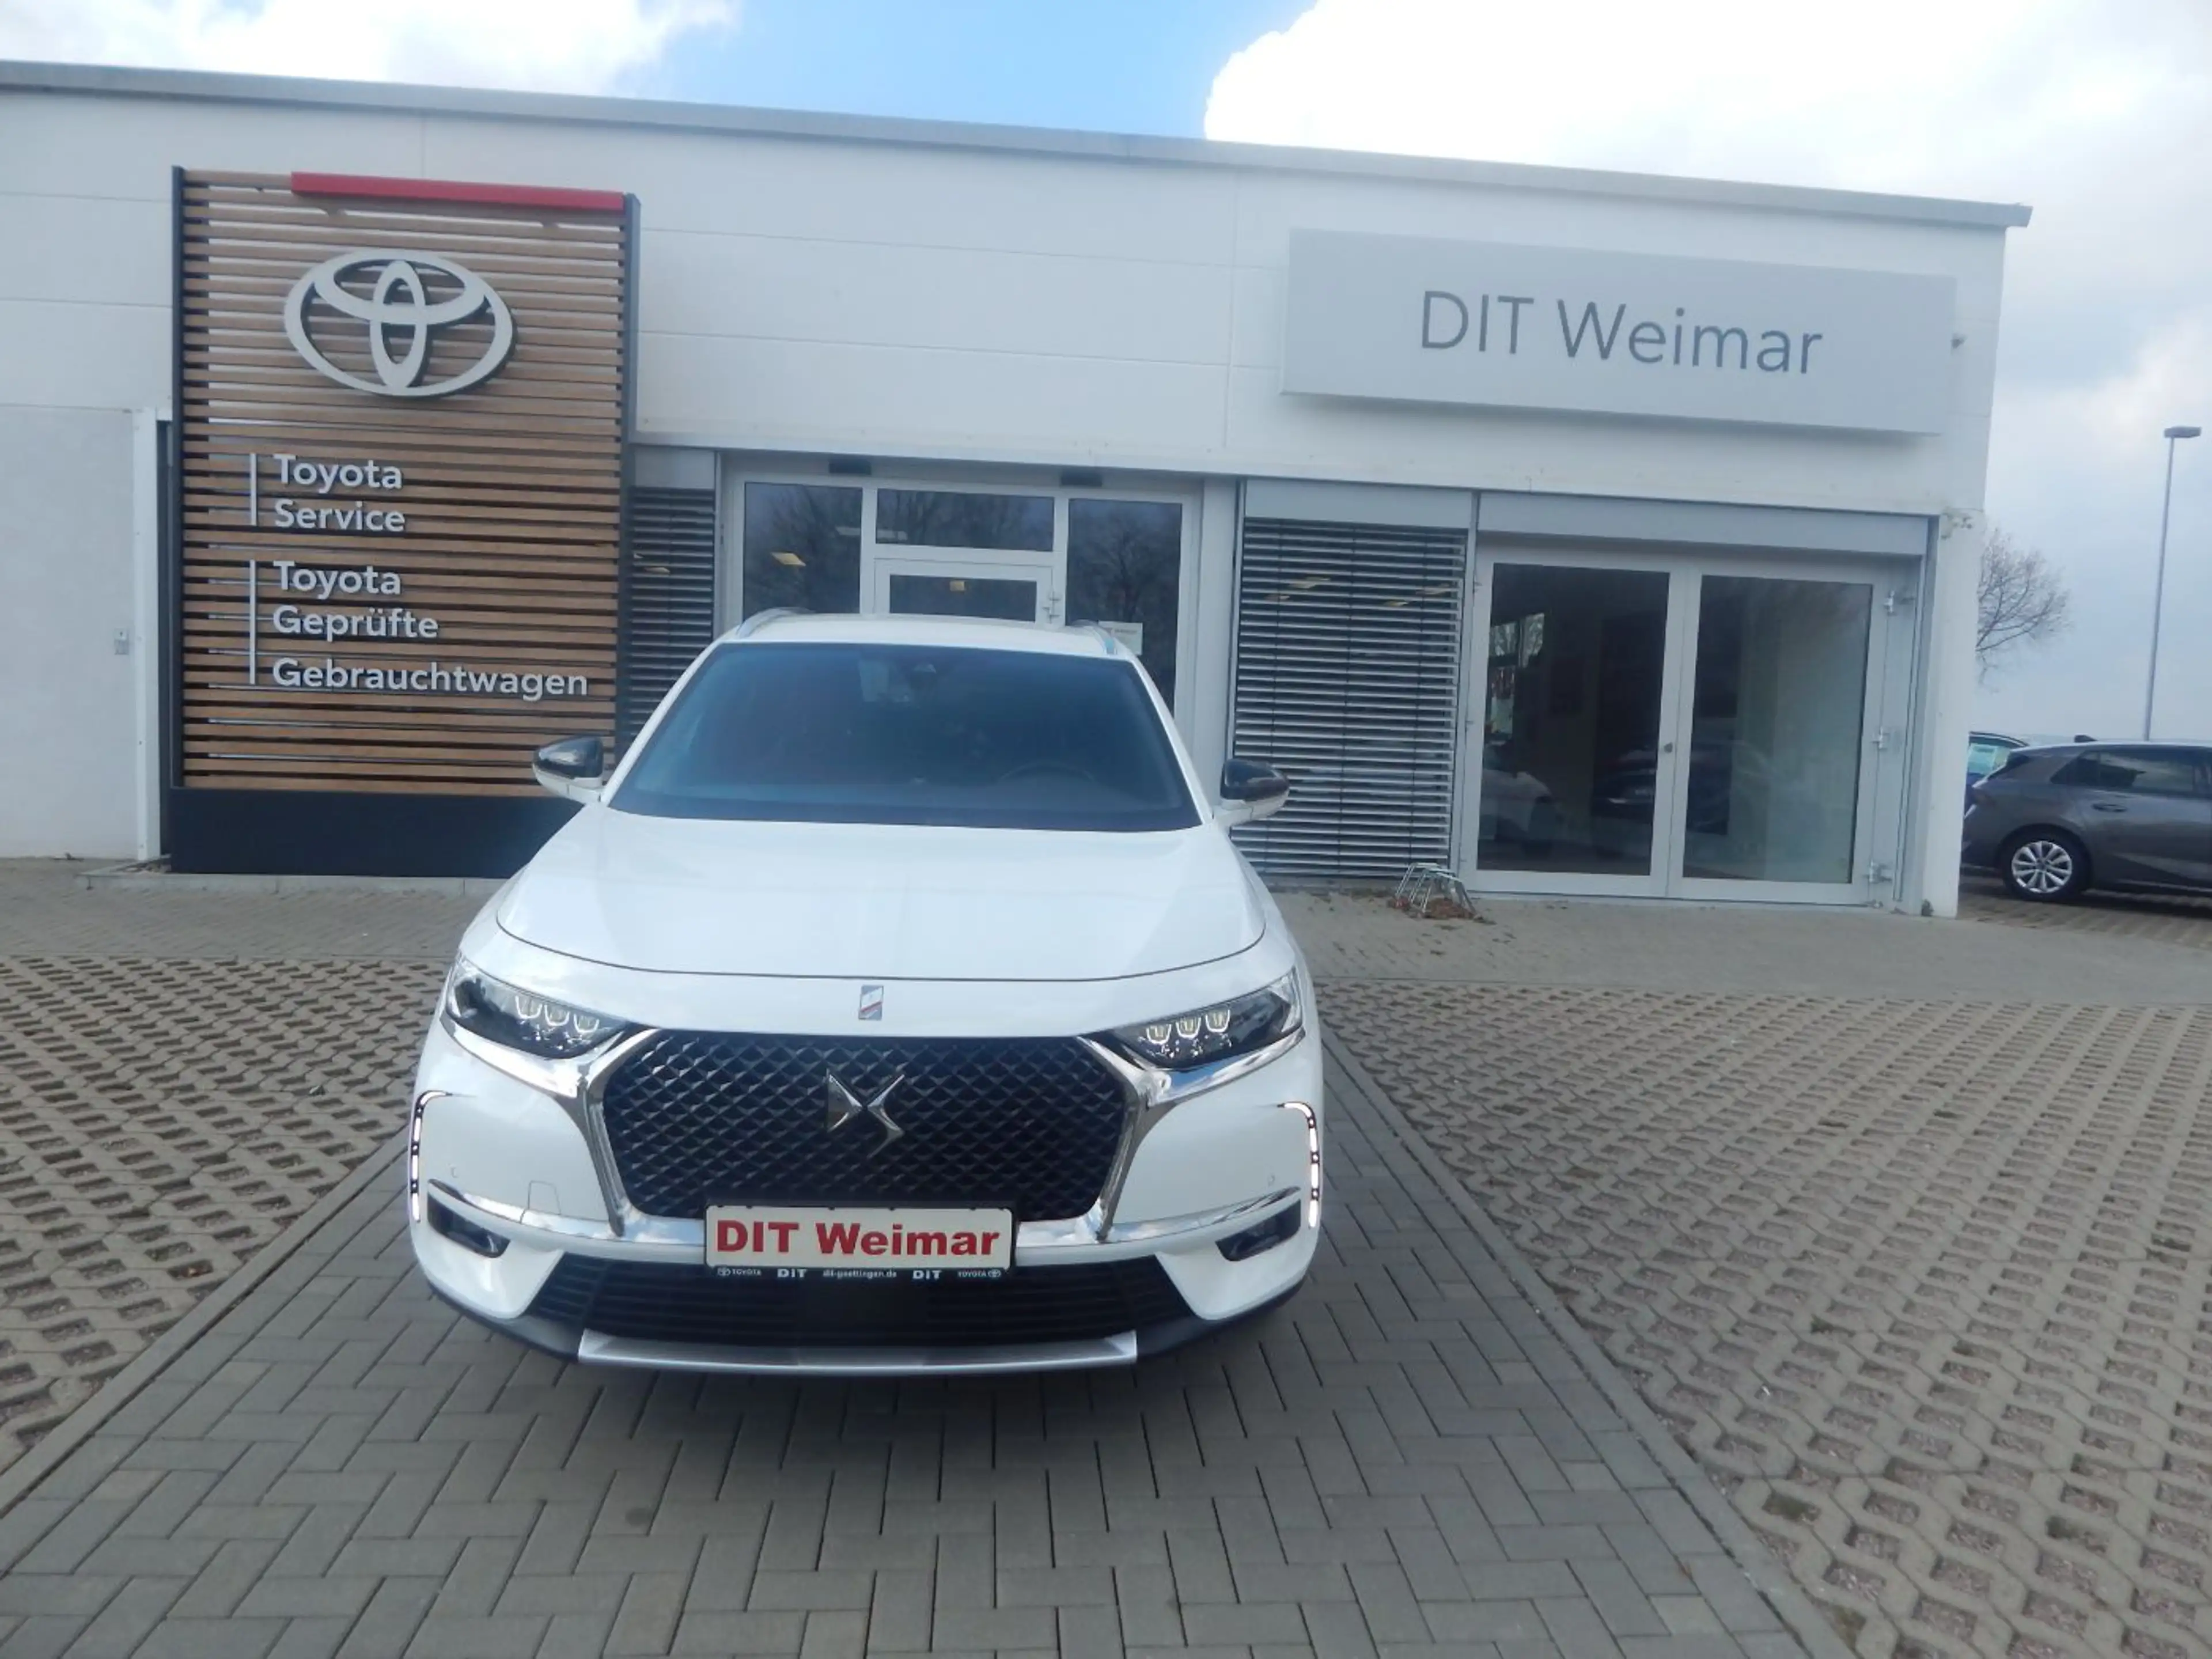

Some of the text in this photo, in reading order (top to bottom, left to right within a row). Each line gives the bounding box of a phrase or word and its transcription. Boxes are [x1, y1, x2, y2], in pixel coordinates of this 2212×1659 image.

[1421, 289, 1823, 374] DIT Weimar
[272, 454, 403, 494] Toyota
[274, 499, 406, 532] Service
[272, 560, 402, 600] Toyota
[272, 605, 439, 642] Geprüfte
[272, 657, 589, 702] Gebrauchtwagen
[717, 1220, 1000, 1256] DIT Weimar
[777, 1268, 806, 1278] DIT
[912, 1270, 942, 1280] DIT
